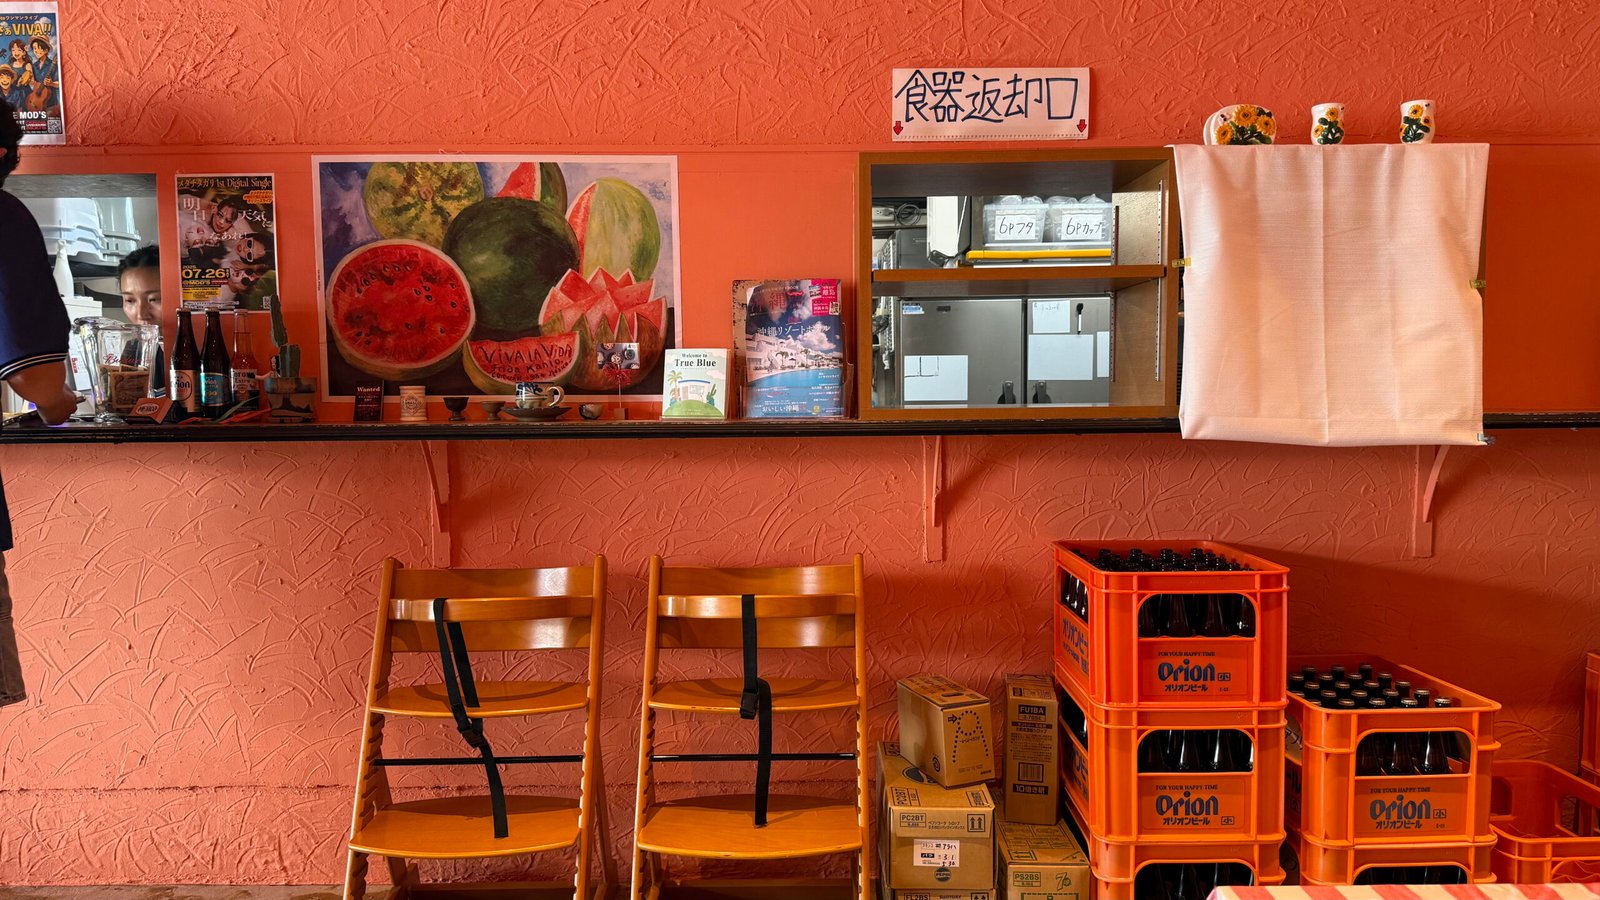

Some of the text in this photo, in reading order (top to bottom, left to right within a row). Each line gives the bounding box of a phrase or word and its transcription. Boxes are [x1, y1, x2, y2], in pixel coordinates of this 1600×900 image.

[894, 69, 1078, 122] 食器返却口
[20, 111, 47, 119] MOD'S
[227, 178, 249, 189] Digital
[251, 177, 271, 189] Single
[182, 268, 226, 279] 07.26
[675, 359, 717, 367] True Blue
[1164, 684, 1209, 692] オリオンビール
[1162, 817, 1211, 825] オリオンビール
[1375, 820, 1423, 829] オリオンビール
[1014, 873, 1040, 881] PS2BS
